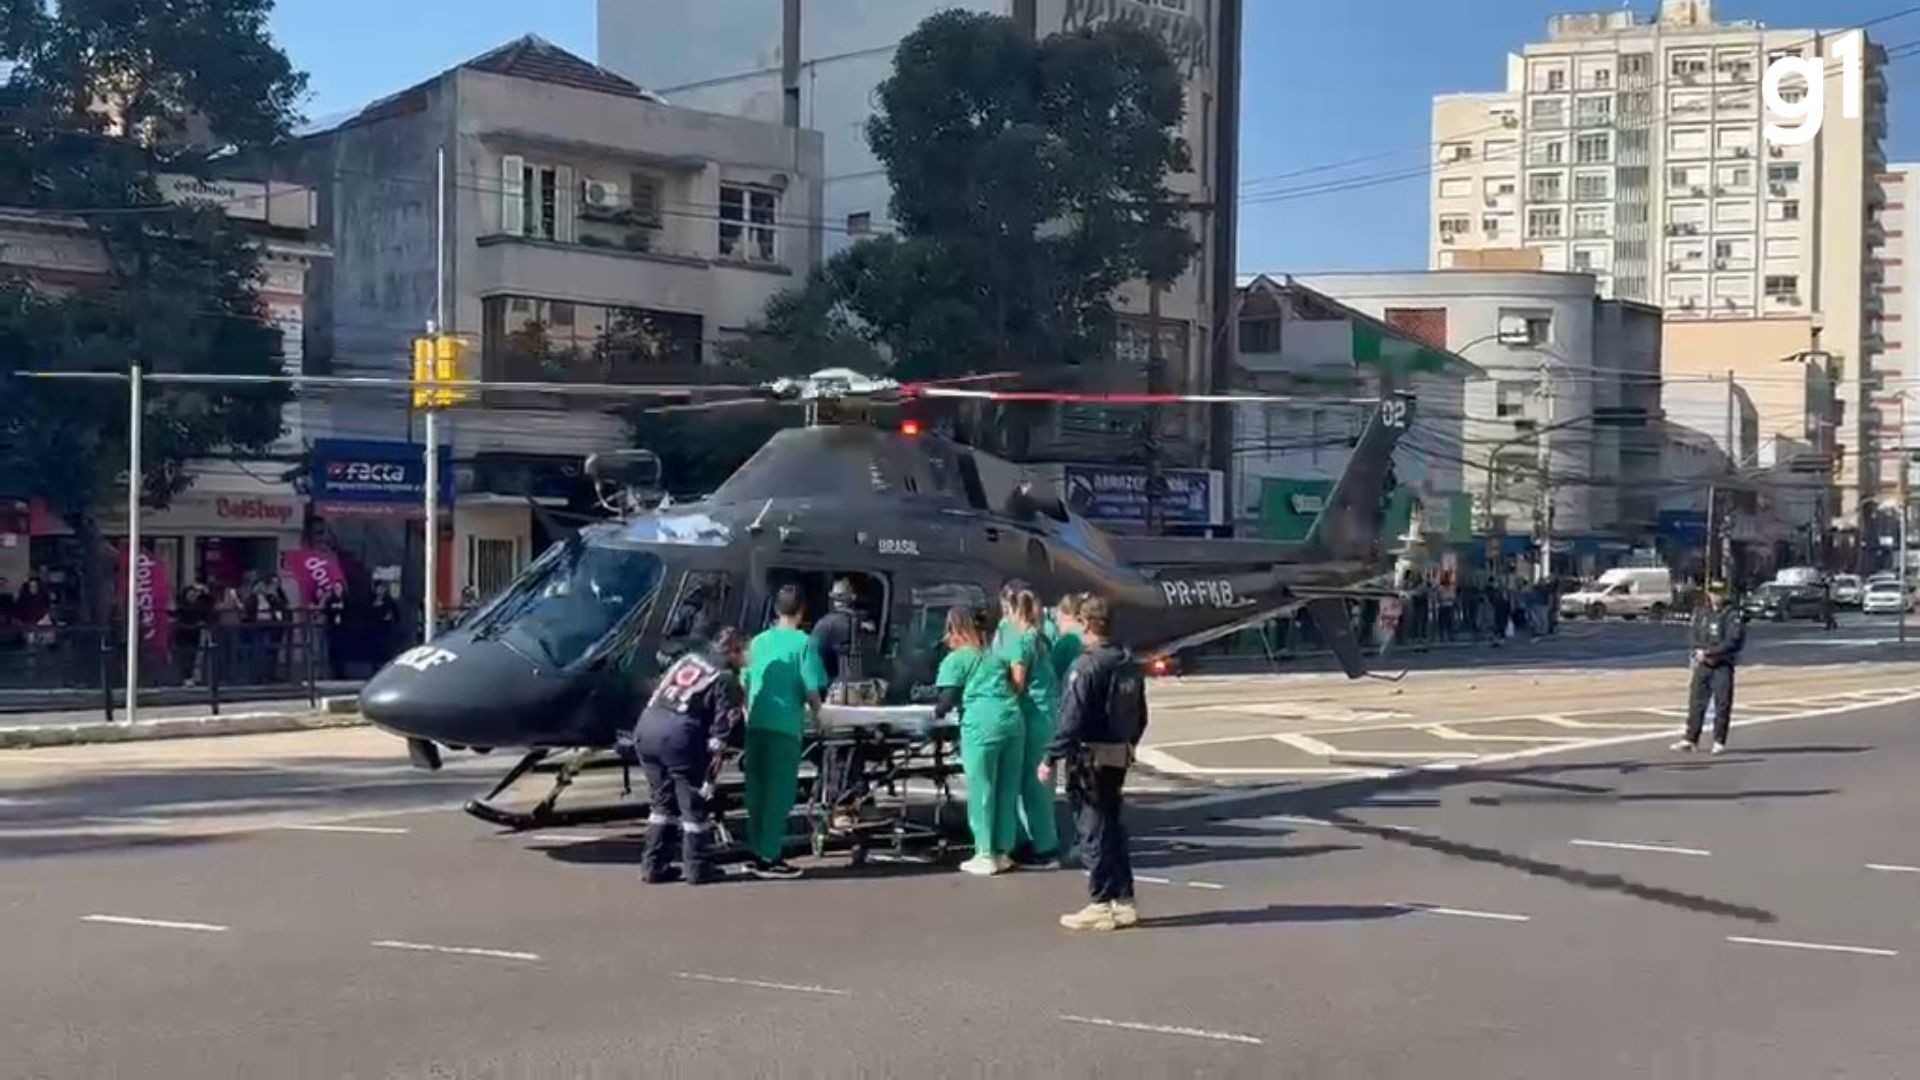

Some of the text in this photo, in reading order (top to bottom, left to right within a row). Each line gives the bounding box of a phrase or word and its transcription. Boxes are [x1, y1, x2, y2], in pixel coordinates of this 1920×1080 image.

[173, 179, 236, 197] estamos
[1382, 400, 1405, 427] 02
[346, 463, 405, 482] facta
